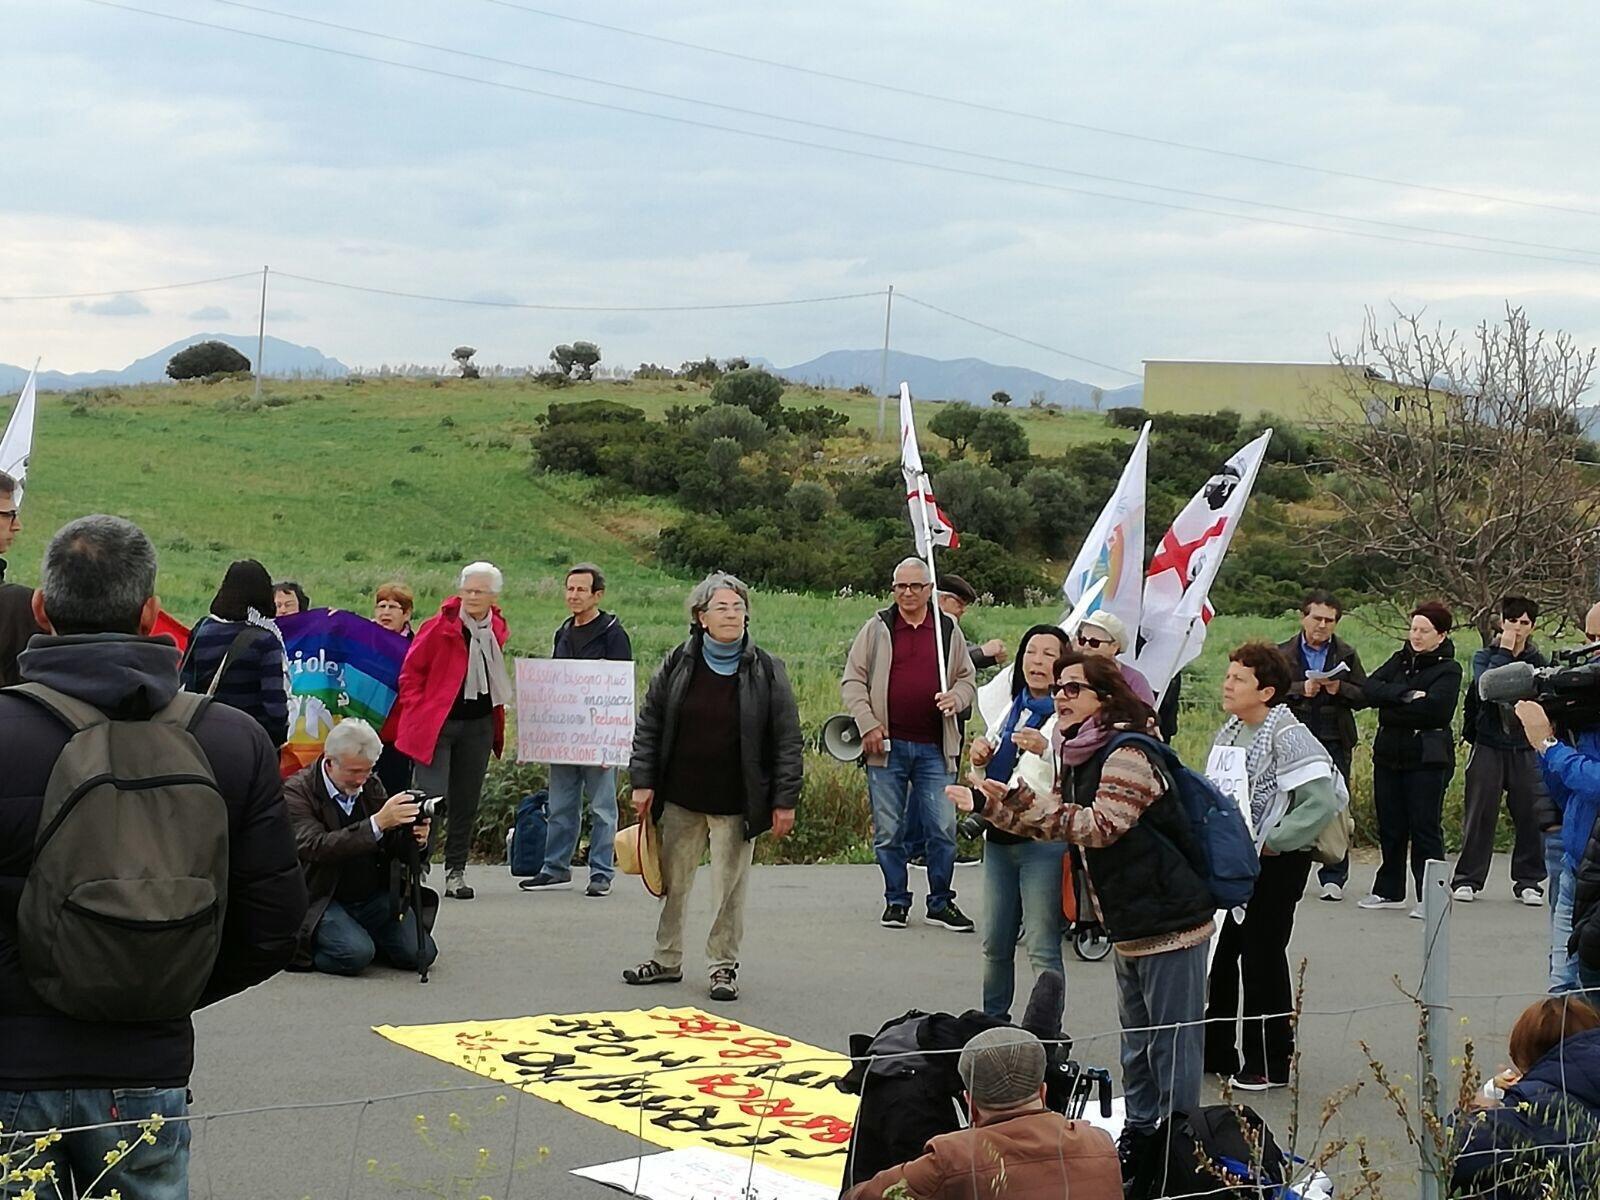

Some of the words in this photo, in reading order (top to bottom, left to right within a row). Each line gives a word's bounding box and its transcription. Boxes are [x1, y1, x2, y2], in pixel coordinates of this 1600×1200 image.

[564, 664, 603, 695] bisogno
[521, 743, 598, 762] RICONVERSIONE
[1215, 751, 1236, 772] NO
[536, 1018, 706, 1068] MORTE
[686, 1073, 853, 1144] BBRICA
